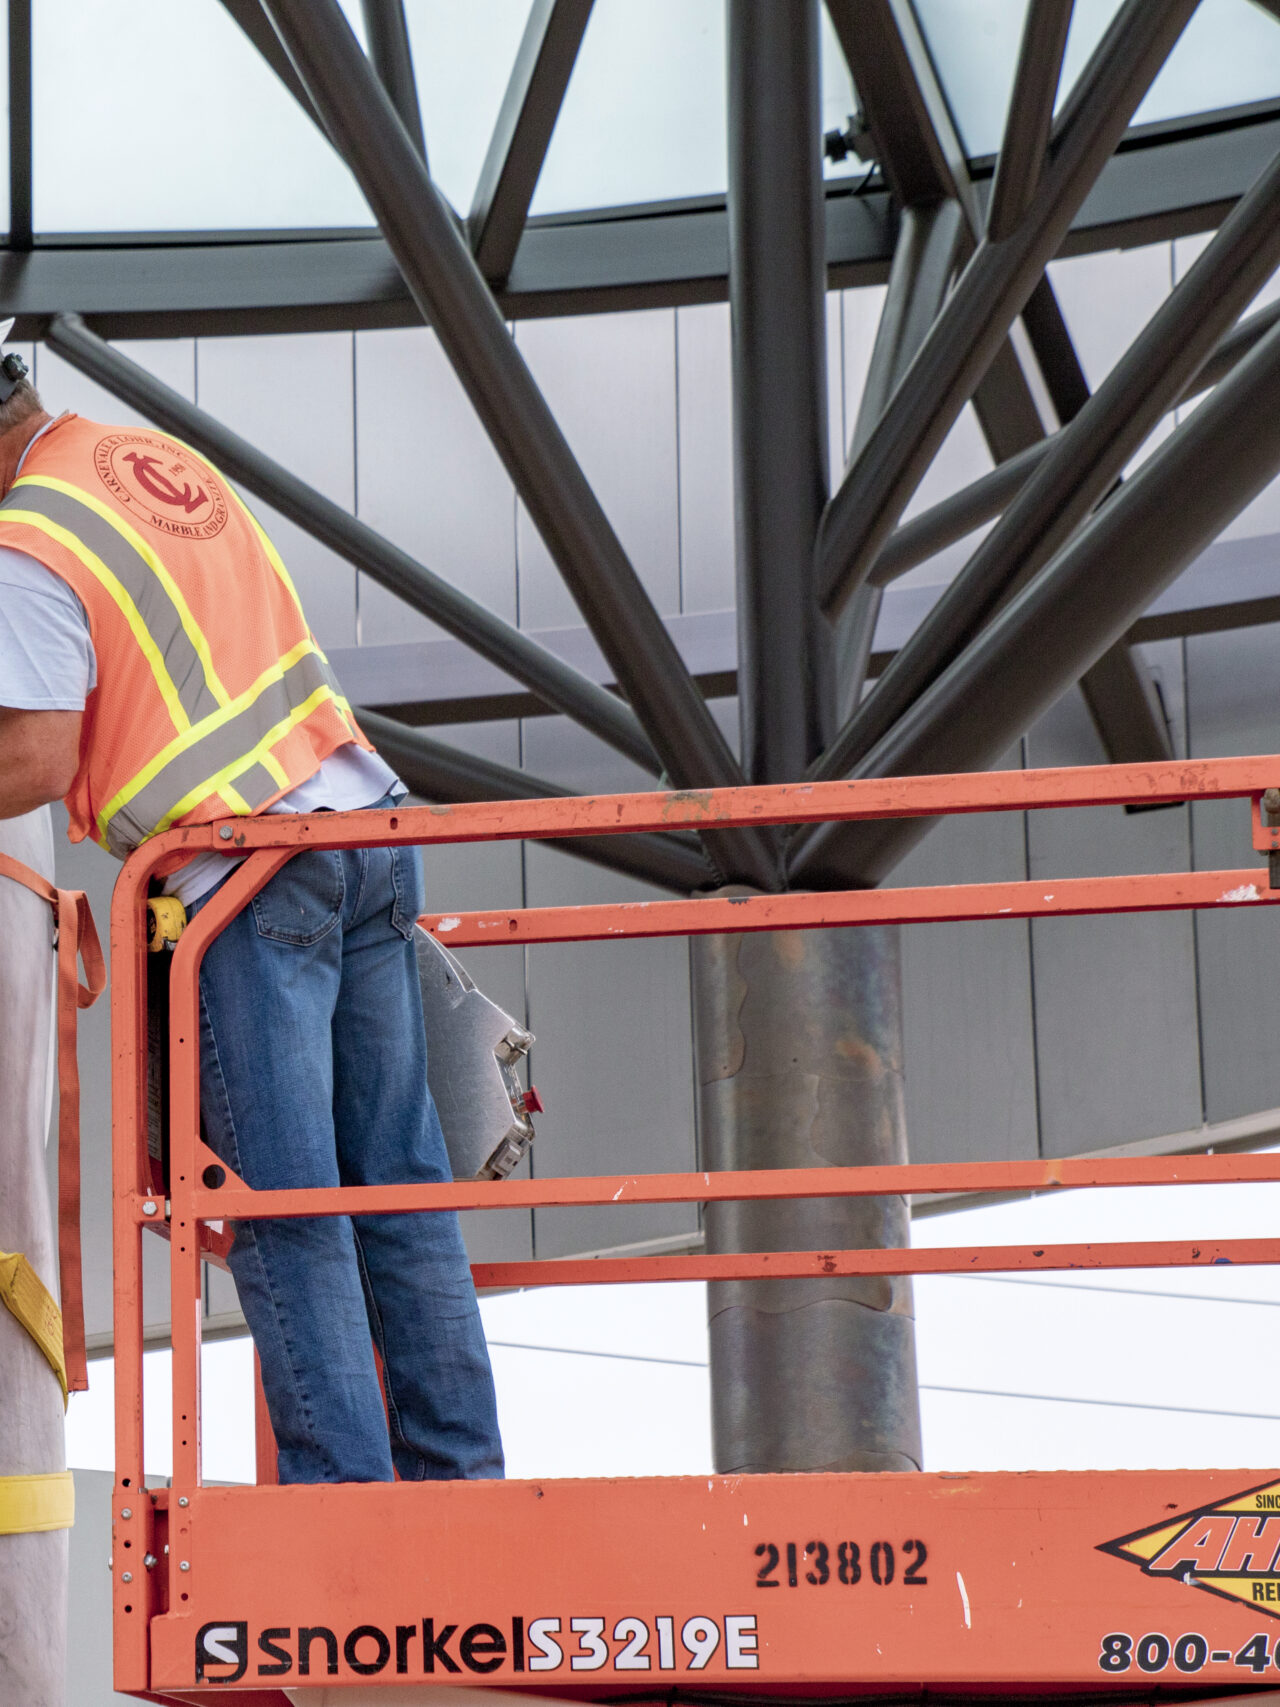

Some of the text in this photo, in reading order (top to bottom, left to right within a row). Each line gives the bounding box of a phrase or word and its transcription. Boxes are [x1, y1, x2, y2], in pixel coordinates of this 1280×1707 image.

[151, 515, 203, 537] MARBLE
[754, 1539, 928, 1588] 213802
[1252, 1582, 1280, 1601] RE
[257, 1617, 525, 1676] snorkel
[526, 1614, 760, 1672] S3219E
[1098, 1632, 1280, 1673] 800-4
